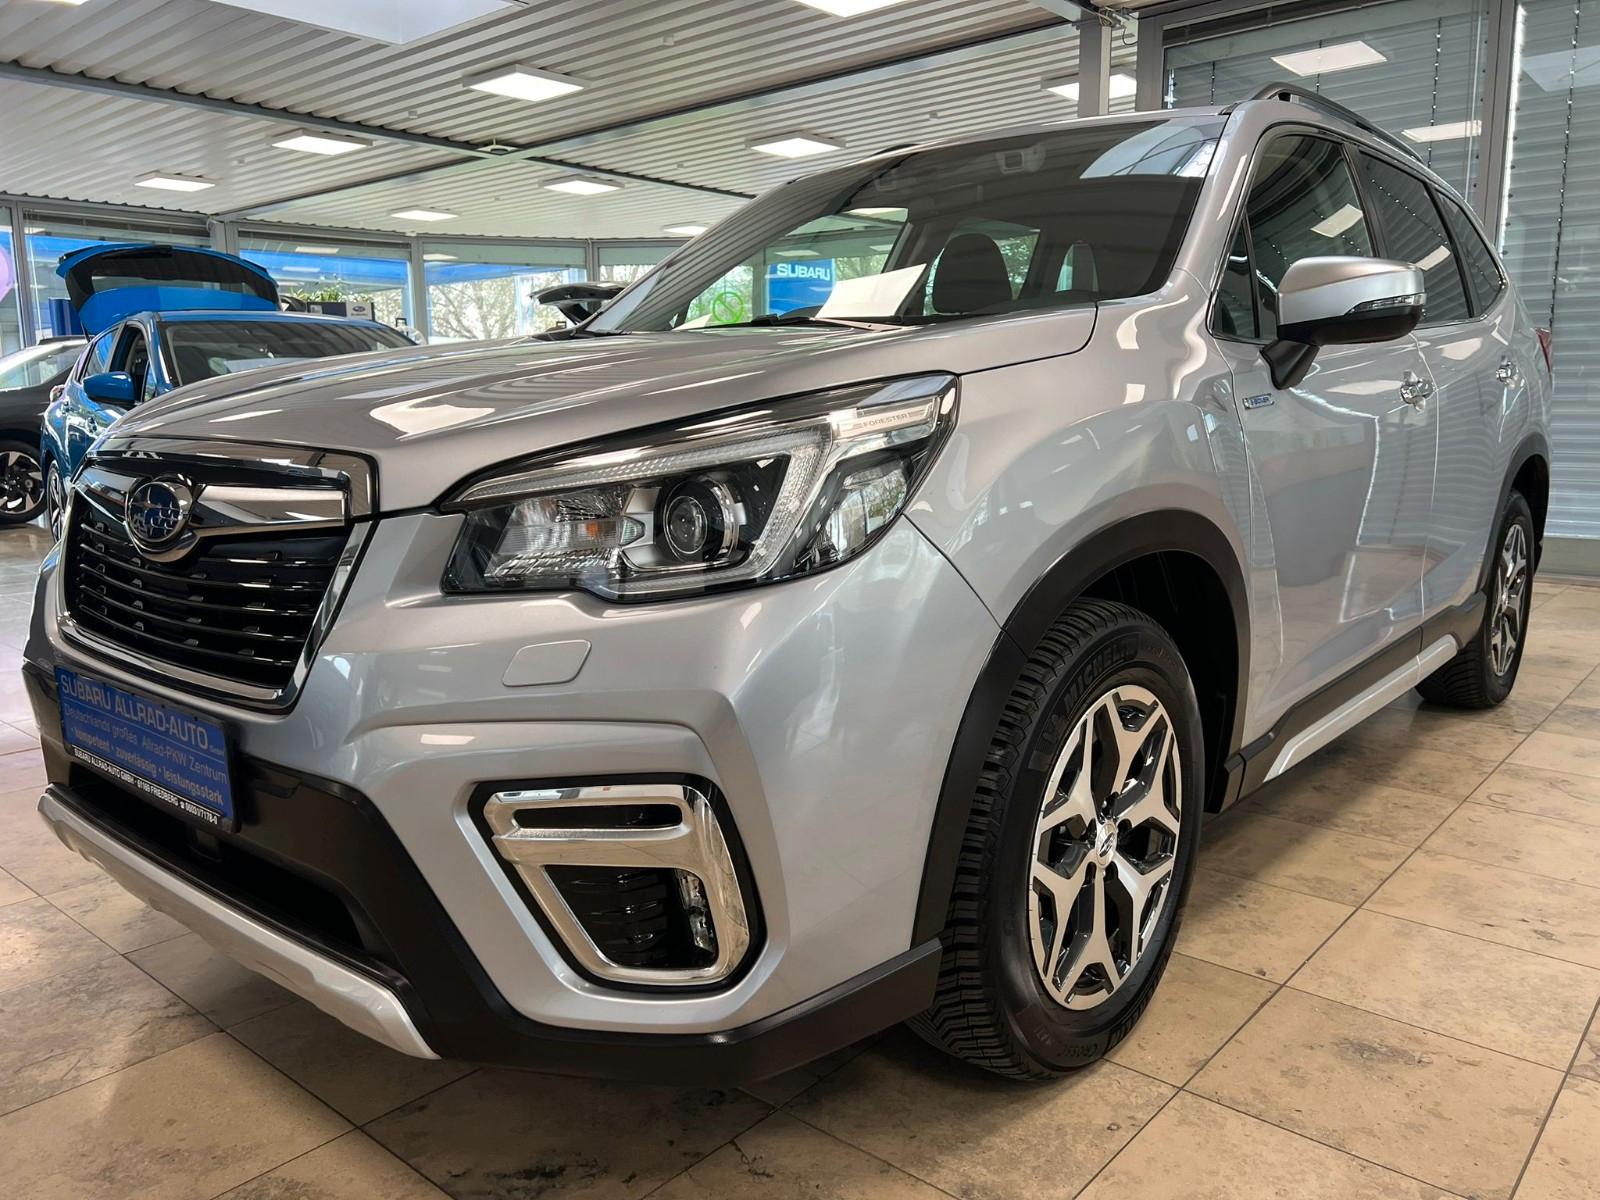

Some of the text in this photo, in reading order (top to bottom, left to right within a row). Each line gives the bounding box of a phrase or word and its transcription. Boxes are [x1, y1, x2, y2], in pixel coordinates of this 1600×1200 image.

[777, 263, 830, 280] SUBARU
[863, 412, 909, 427] FORESTER
[61, 674, 208, 749] SUBARU ALLRAD-AUTO
[189, 756, 228, 785] Zentrum
[163, 766, 224, 806] leistungsstark
